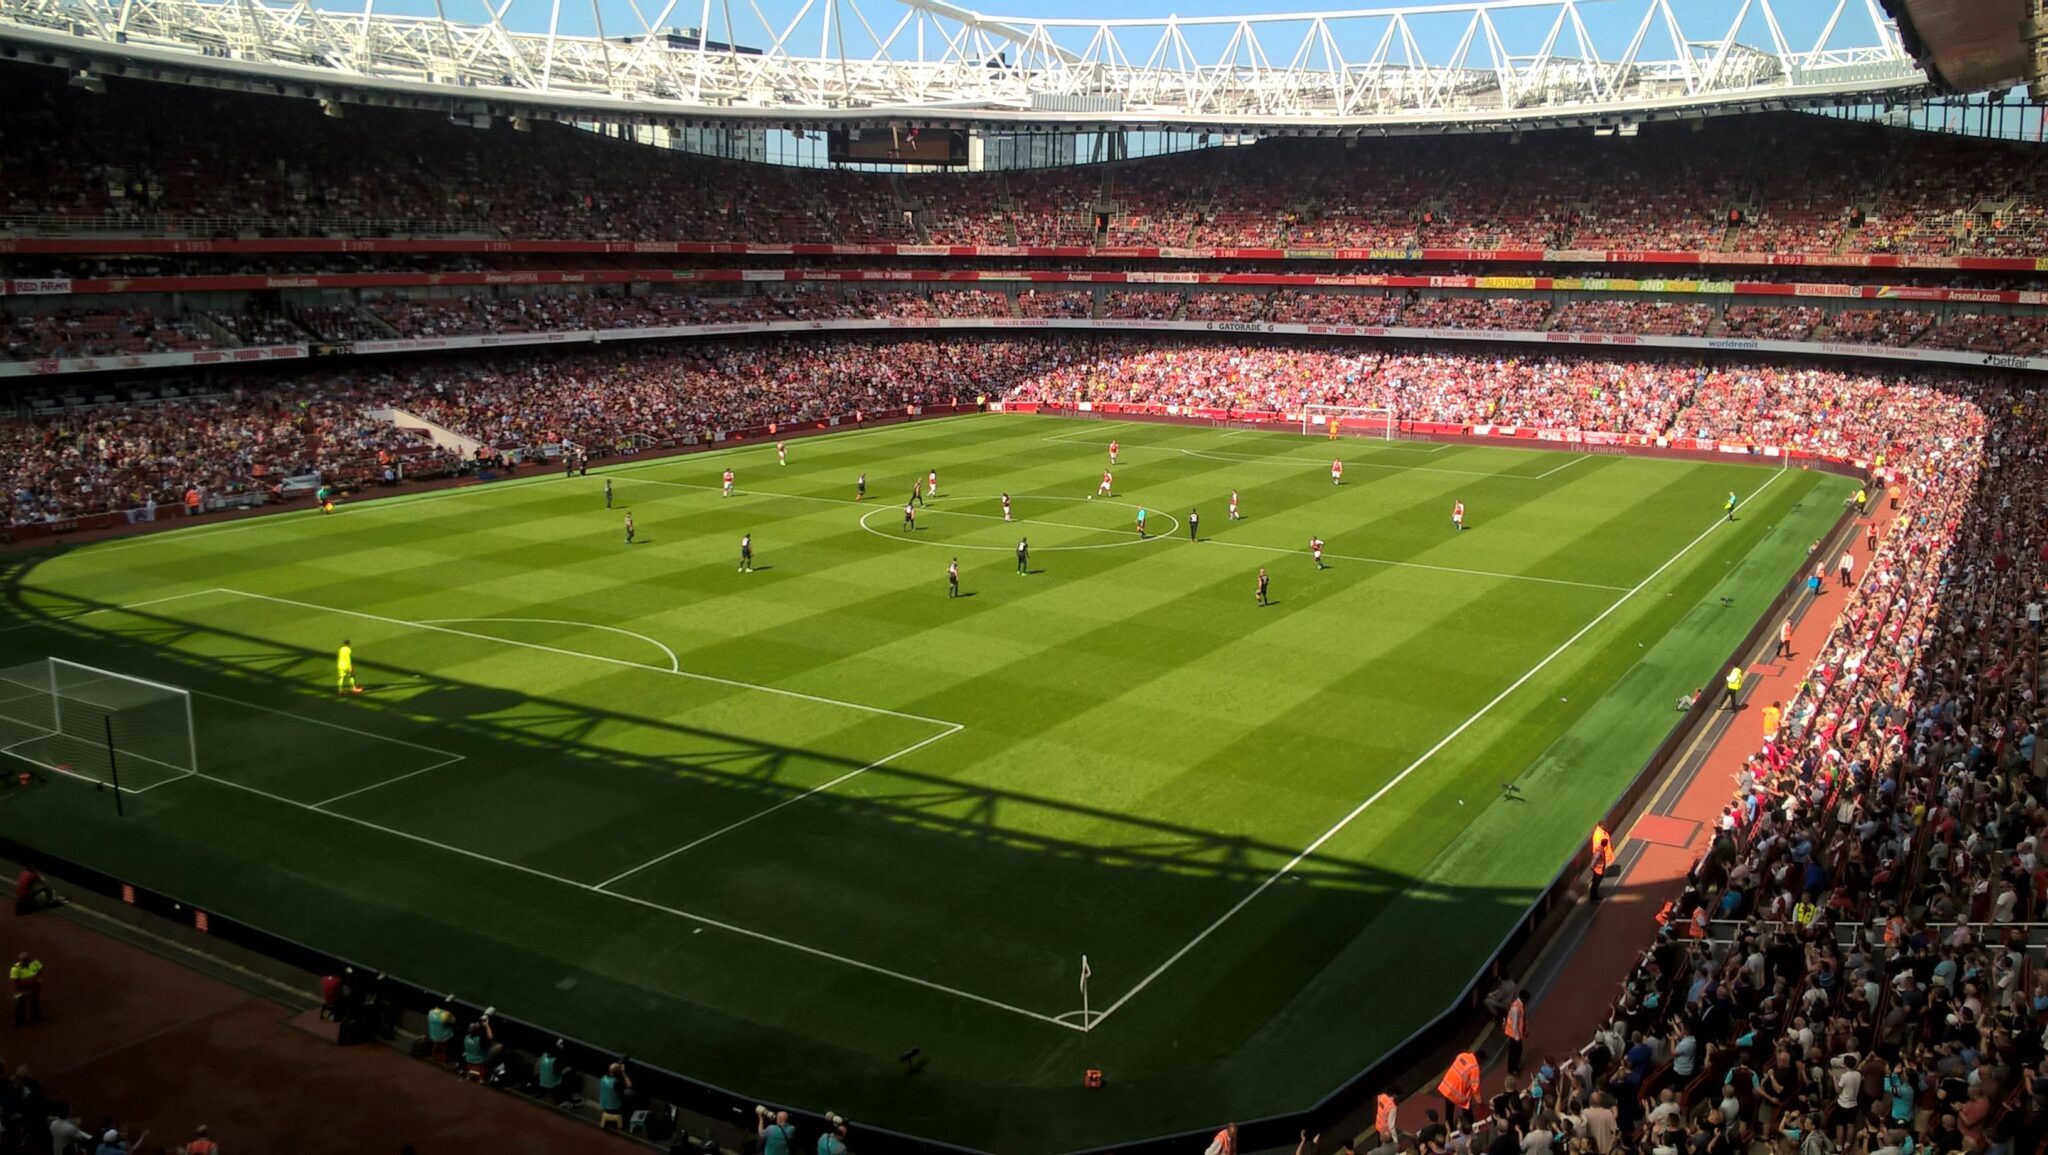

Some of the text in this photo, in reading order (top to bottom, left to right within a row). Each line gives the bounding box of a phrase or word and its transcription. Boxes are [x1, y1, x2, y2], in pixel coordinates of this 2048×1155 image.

[1343, 251, 1363, 259] 1989
[1369, 250, 1407, 259] ANFIELD
[1622, 253, 1645, 261] 1993
[1778, 256, 1802, 264] 1993
[561, 273, 585, 282] Arsenal
[803, 271, 841, 279] Arsenal.com
[16, 281, 68, 291] RED ARMY
[267, 277, 318, 288] Arsenal.com
[1314, 277, 1355, 285] Arsenal.com
[1485, 278, 1534, 288] AUSTRALIA
[1583, 280, 1608, 290] AND
[1640, 280, 1665, 291] AND
[1698, 281, 1734, 293] AGAIN
[1798, 284, 1851, 297] ARSENAL FRANCE
[1948, 290, 2001, 302] Arsenal.com
[1218, 323, 1262, 332] GATORADE
[1546, 333, 1569, 341] PUMA
[1612, 336, 1636, 344] PUMA
[1709, 340, 1758, 349] worldremit
[193, 347, 298, 362] PUMA PUMA PUMA
[1993, 355, 2031, 368] betfair
[1588, 444, 1627, 454] Emirates
